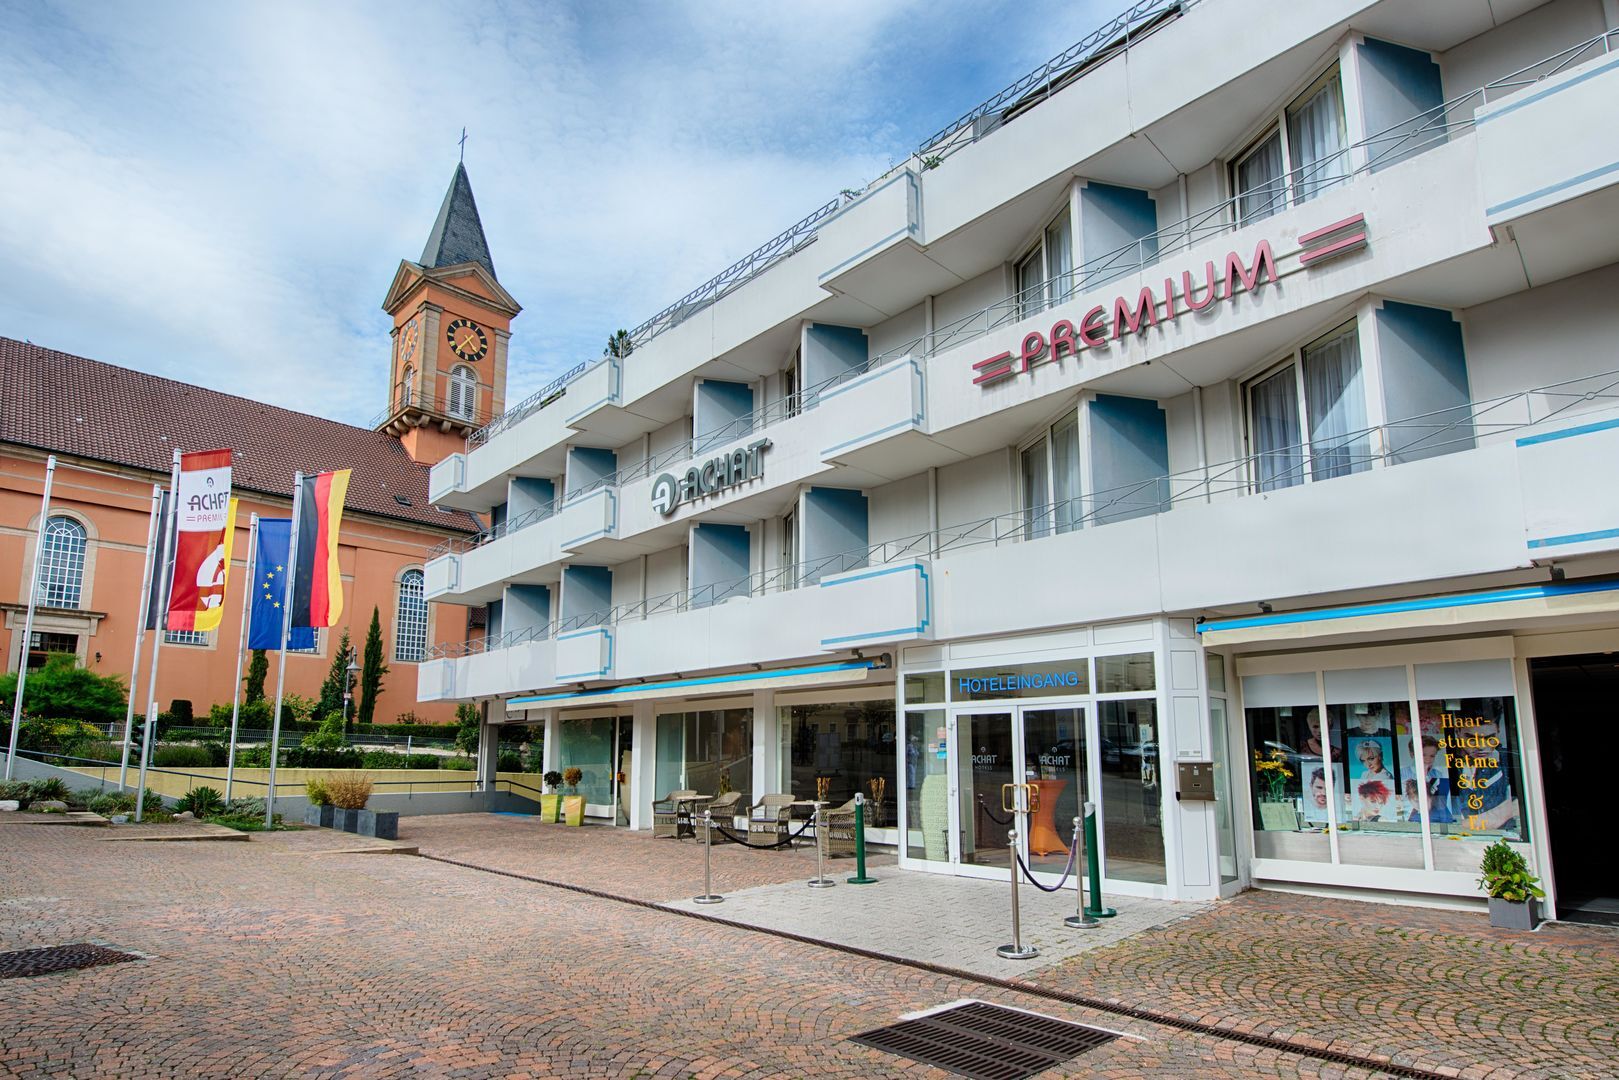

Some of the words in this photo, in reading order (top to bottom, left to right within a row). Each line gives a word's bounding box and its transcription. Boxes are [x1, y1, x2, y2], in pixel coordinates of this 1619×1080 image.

[1021, 239, 1278, 373] PREMIUM
[681, 437, 771, 501] ACHAT
[187, 491, 229, 511] ACHAT
[959, 671, 1079, 694] HOTELEINGANG
[1440, 713, 1491, 729] Haar-
[1437, 732, 1500, 749] studio
[971, 754, 998, 764] ACHAT
[1039, 755, 1071, 766] ACHAT
[1444, 753, 1499, 769] Fatma
[1457, 773, 1489, 789] Sie
[1467, 793, 1484, 810] &
[1468, 814, 1488, 831] Er
